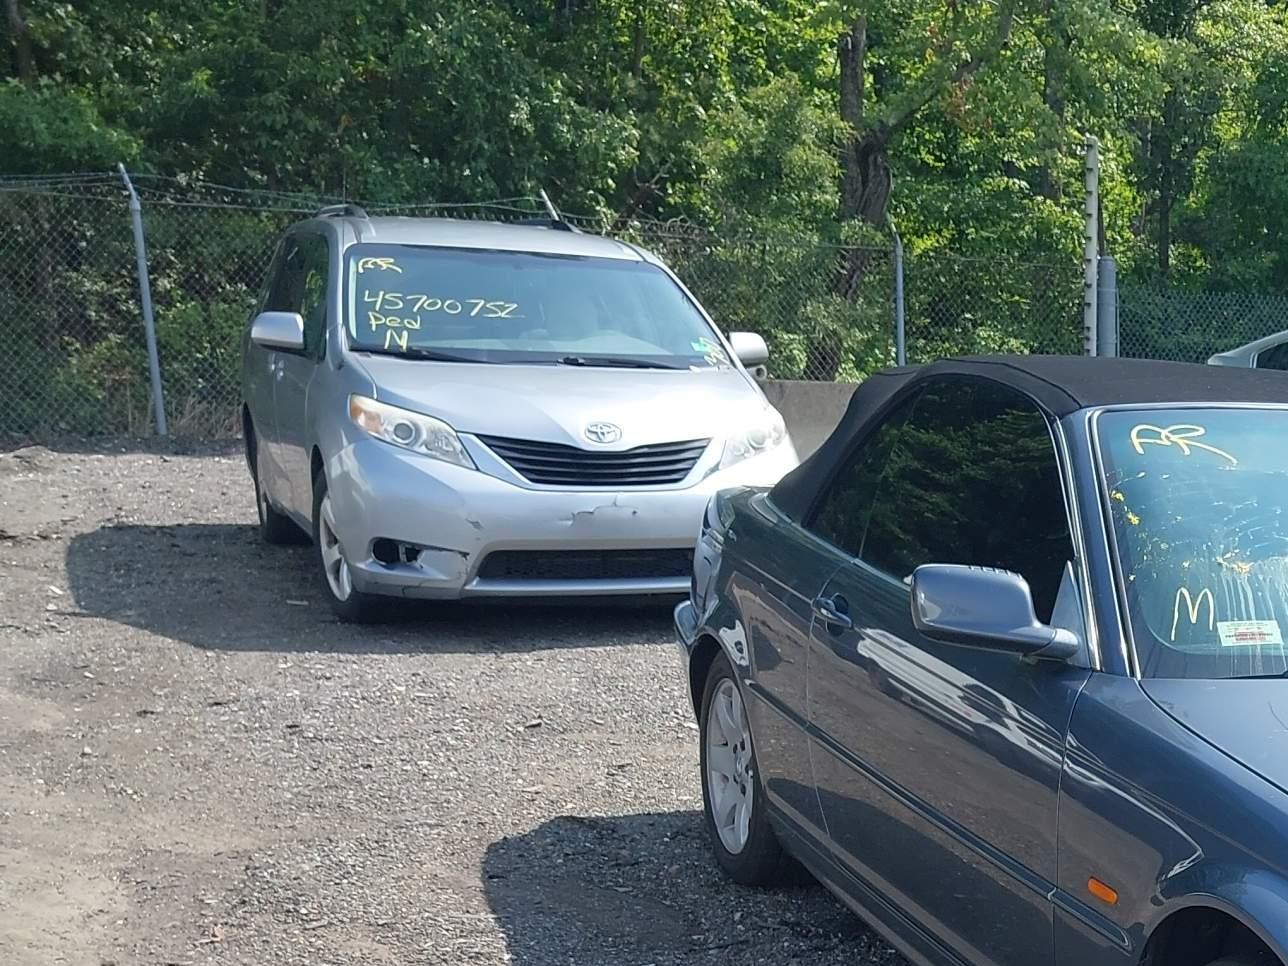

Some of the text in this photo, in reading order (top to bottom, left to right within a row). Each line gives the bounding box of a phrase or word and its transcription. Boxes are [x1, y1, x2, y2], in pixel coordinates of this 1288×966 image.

[364, 289, 526, 318] 45700752
[1131, 424, 1238, 465] AR
[1170, 587, 1215, 641] M
